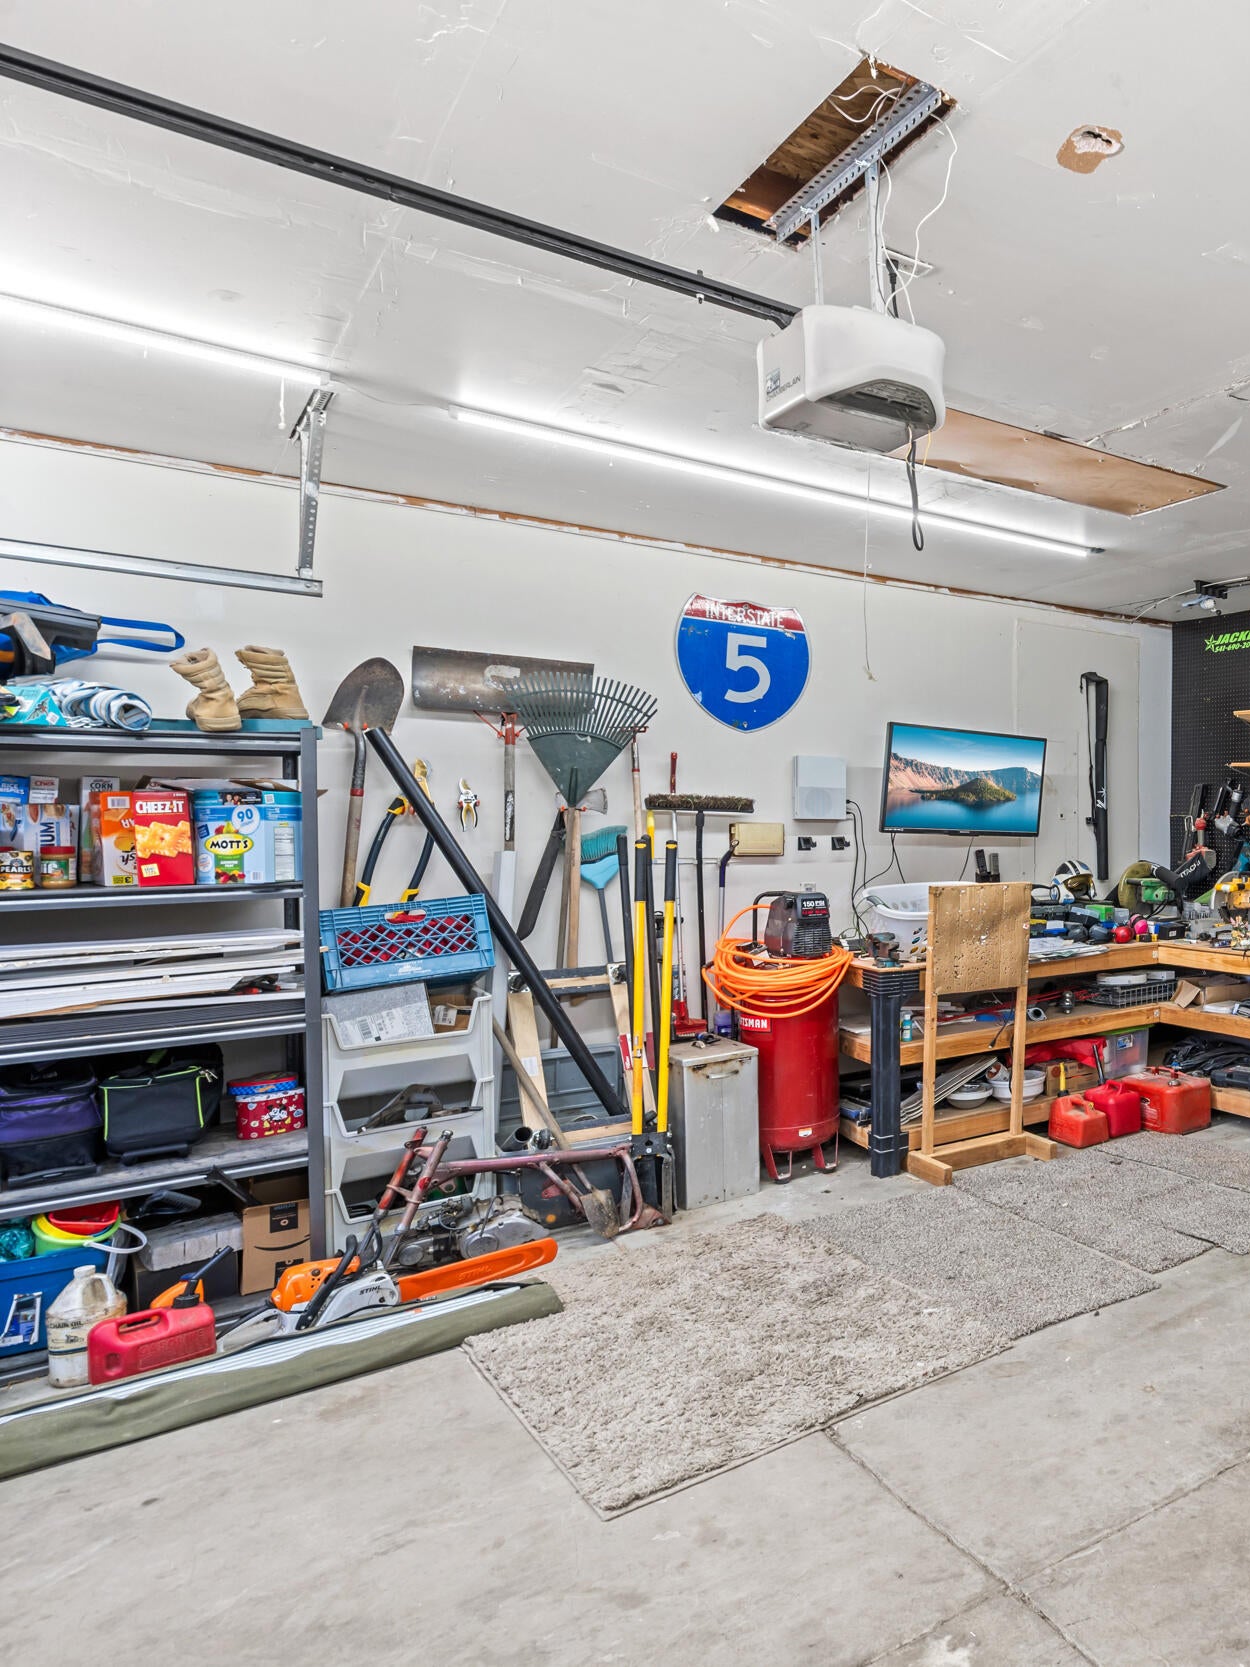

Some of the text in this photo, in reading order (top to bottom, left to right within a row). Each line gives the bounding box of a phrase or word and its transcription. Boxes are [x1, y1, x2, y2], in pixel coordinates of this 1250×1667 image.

[705, 602, 785, 628] INTERSTATE
[724, 632, 771, 703] 5
[90, 782, 113, 790] CORN
[237, 808, 254, 822] 90
[40, 822, 55, 846] IUM
[803, 900, 814, 908] 150
[740, 1017, 768, 1029] TSMAN
[359, 1285, 381, 1295] STIHL
